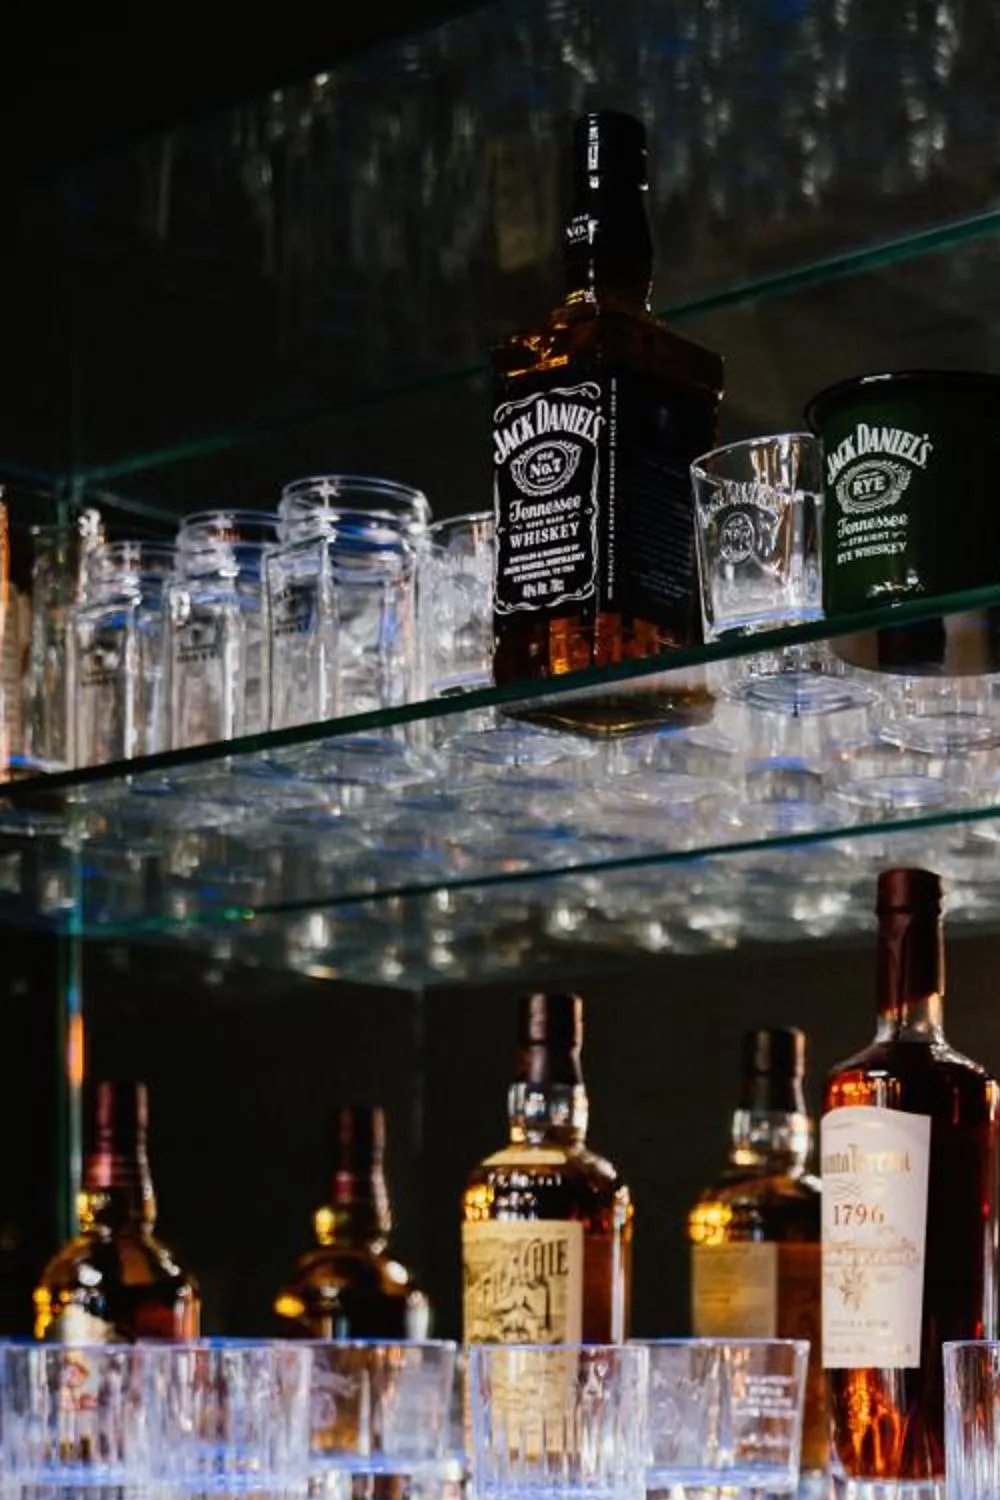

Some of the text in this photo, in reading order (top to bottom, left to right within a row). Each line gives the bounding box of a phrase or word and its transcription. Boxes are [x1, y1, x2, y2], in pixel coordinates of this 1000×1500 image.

[493, 398, 607, 465] JACK DANIEL'S
[827, 423, 933, 486] JACK DANIEL'S
[853, 475, 886, 496] RYE
[509, 495, 581, 522] Tennessee
[509, 521, 579, 548] WHISKEY
[837, 513, 908, 539] Tennessee
[834, 1204, 885, 1226] 1796
